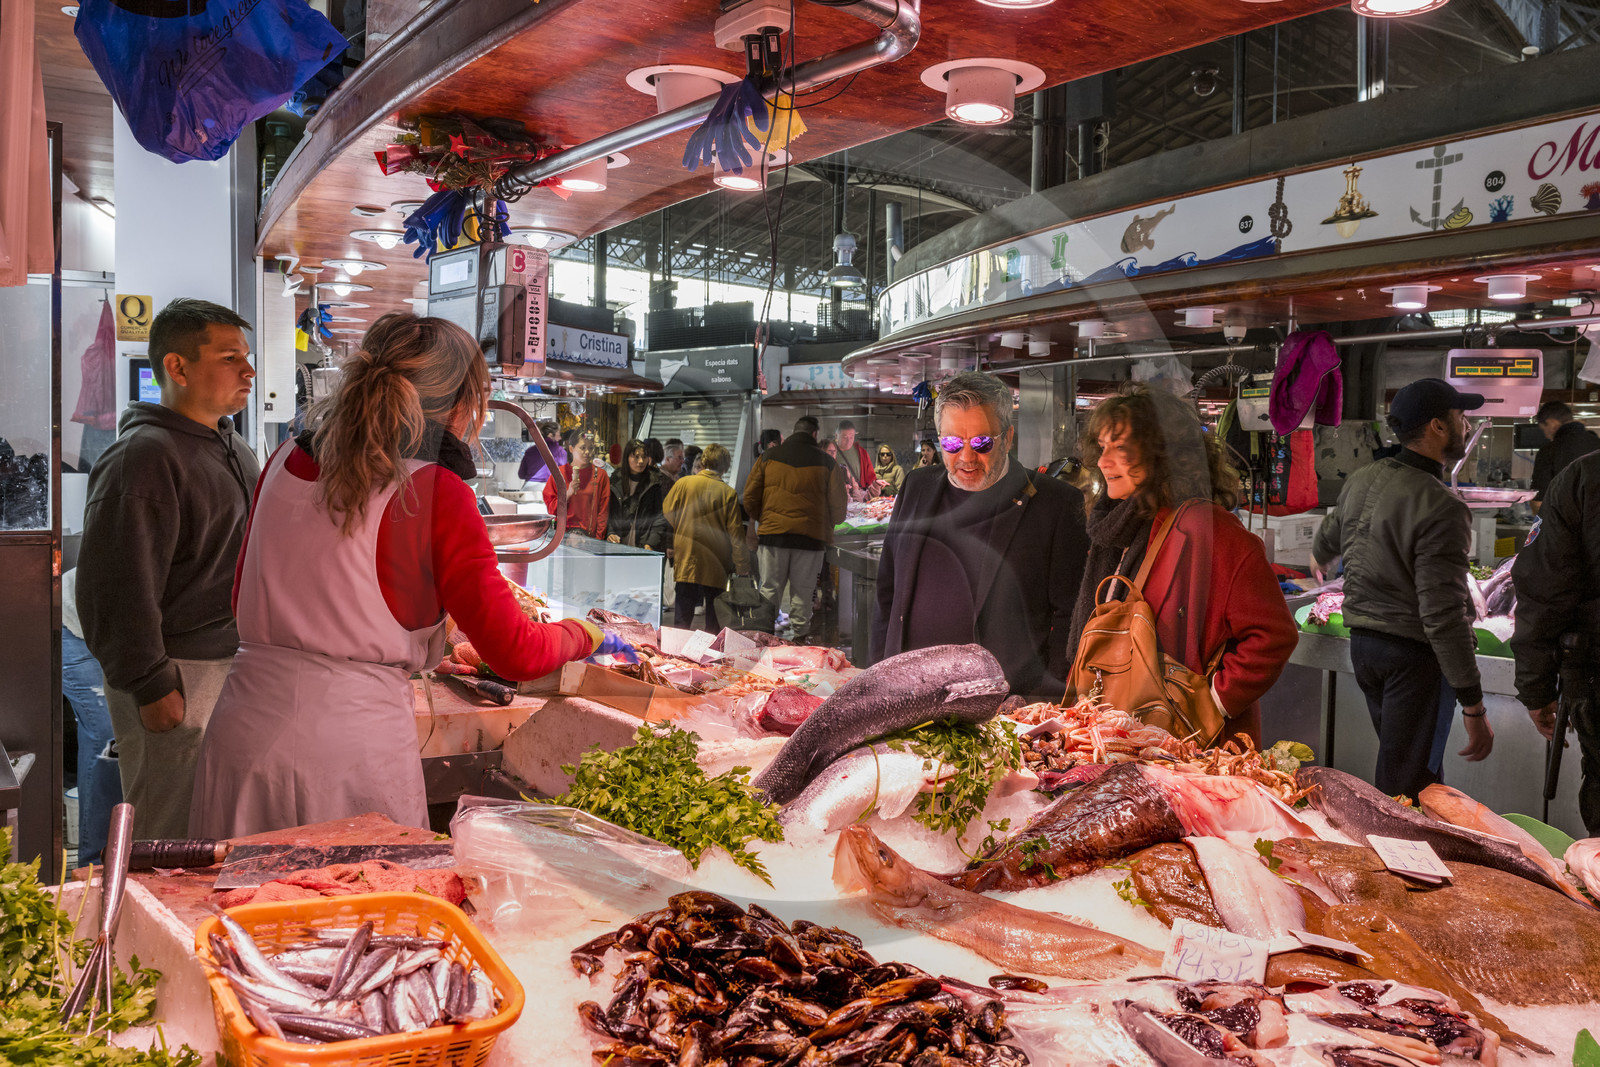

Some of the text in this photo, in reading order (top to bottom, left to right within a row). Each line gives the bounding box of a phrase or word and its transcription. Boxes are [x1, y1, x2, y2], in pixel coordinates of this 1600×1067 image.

[1486, 176, 1505, 188] 804
[1240, 219, 1253, 230] 837
[120, 296, 148, 326] Q
[580, 333, 622, 355] Cristina
